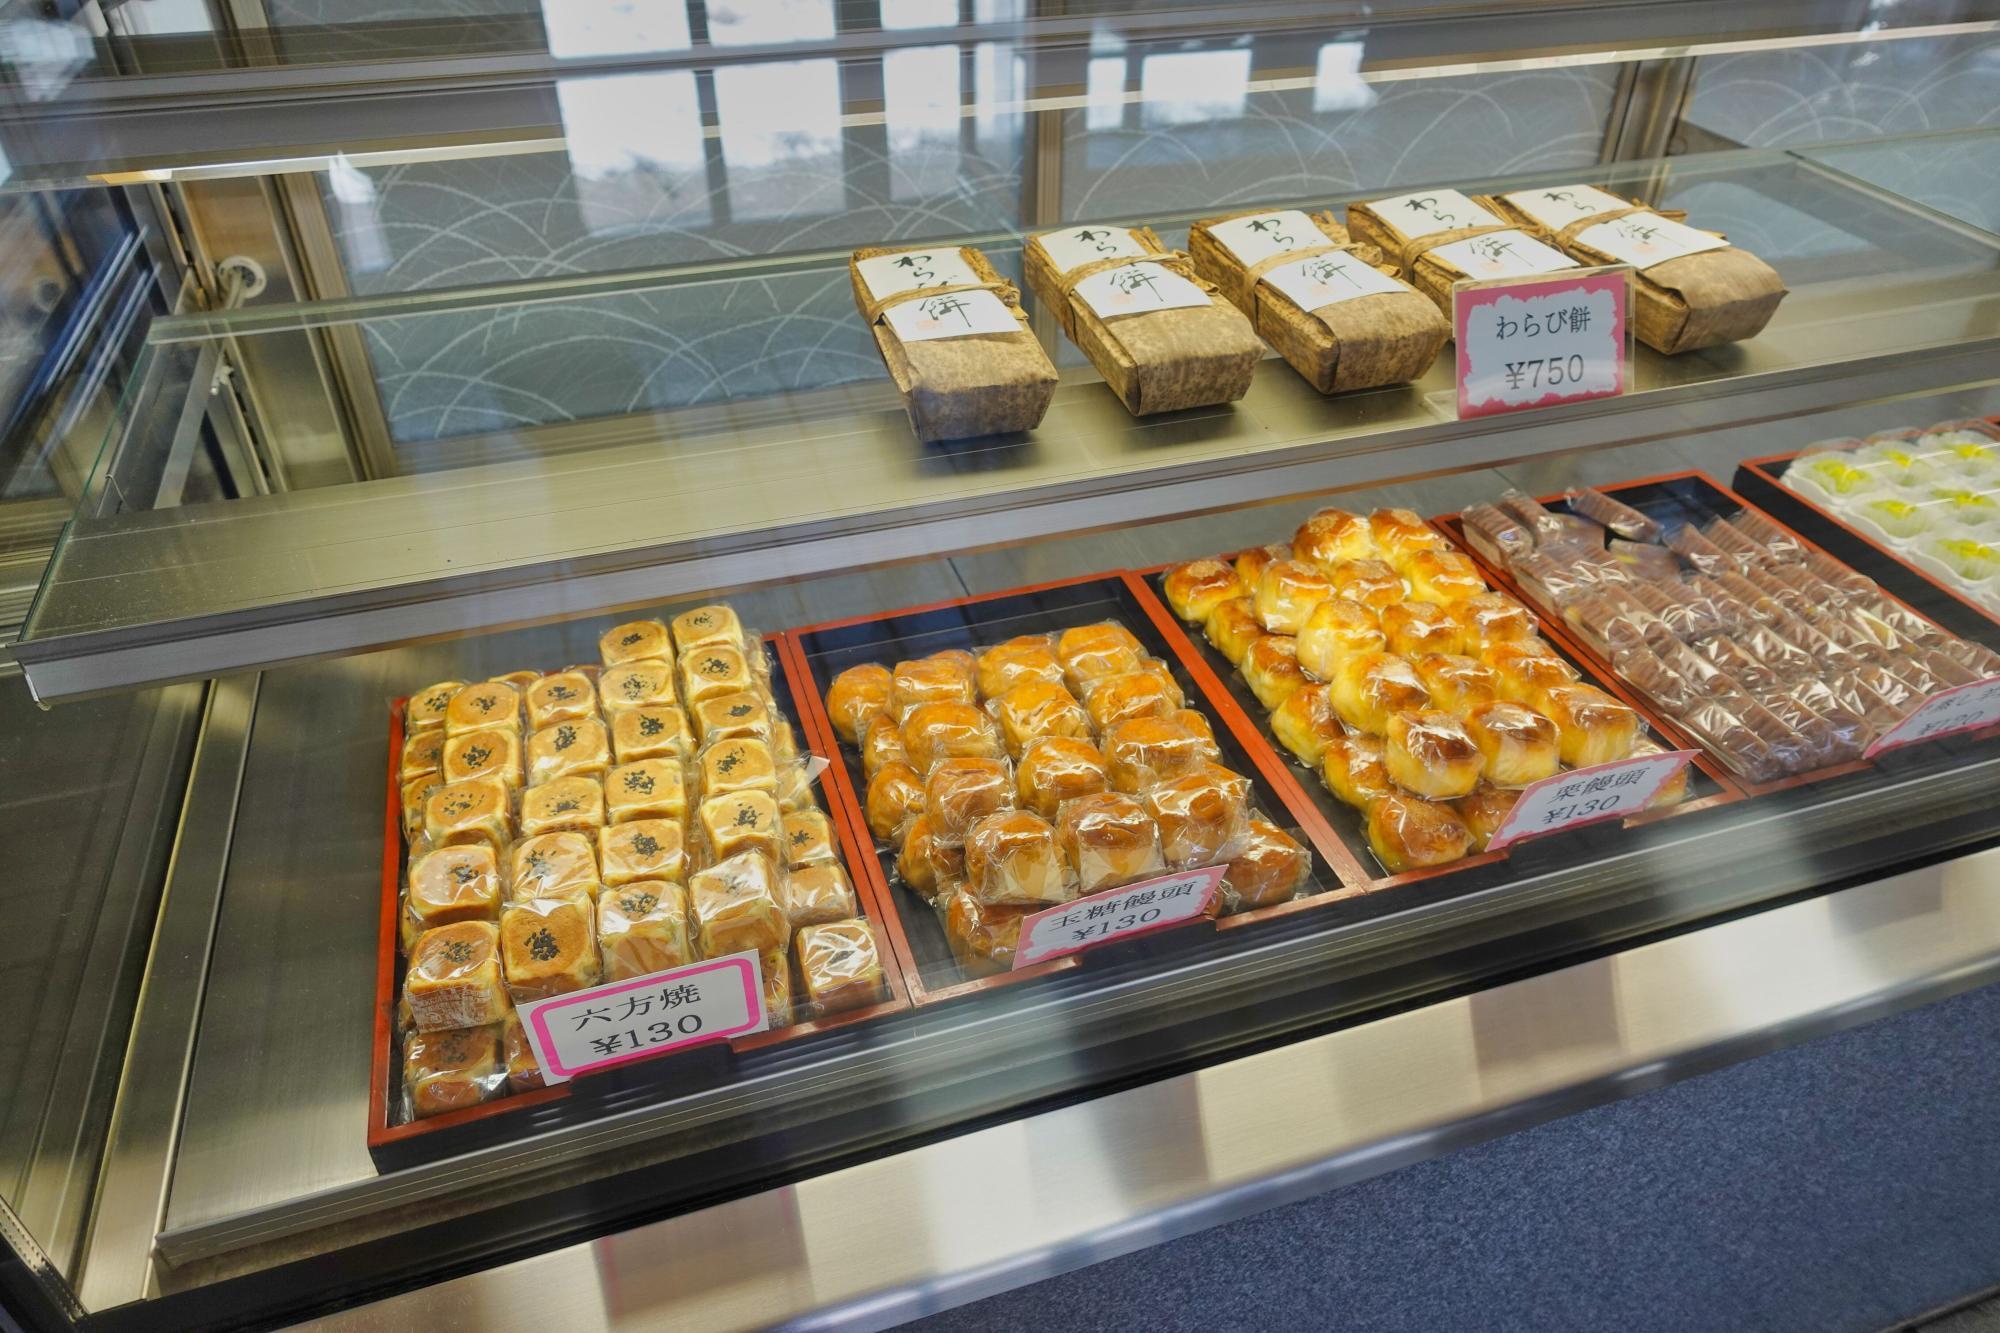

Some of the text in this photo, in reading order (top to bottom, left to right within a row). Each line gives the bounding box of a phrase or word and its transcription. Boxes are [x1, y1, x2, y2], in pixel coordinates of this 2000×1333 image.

[1495, 305, 1592, 341] わらび餅
[1504, 353, 1585, 390] ¥750
[1546, 766, 1650, 805] 栗饅頭
[1542, 794, 1621, 825] ¥130
[1071, 907, 1162, 942] ¥130
[570, 983, 702, 1032] 六方焼
[589, 1013, 703, 1056] ¥130
